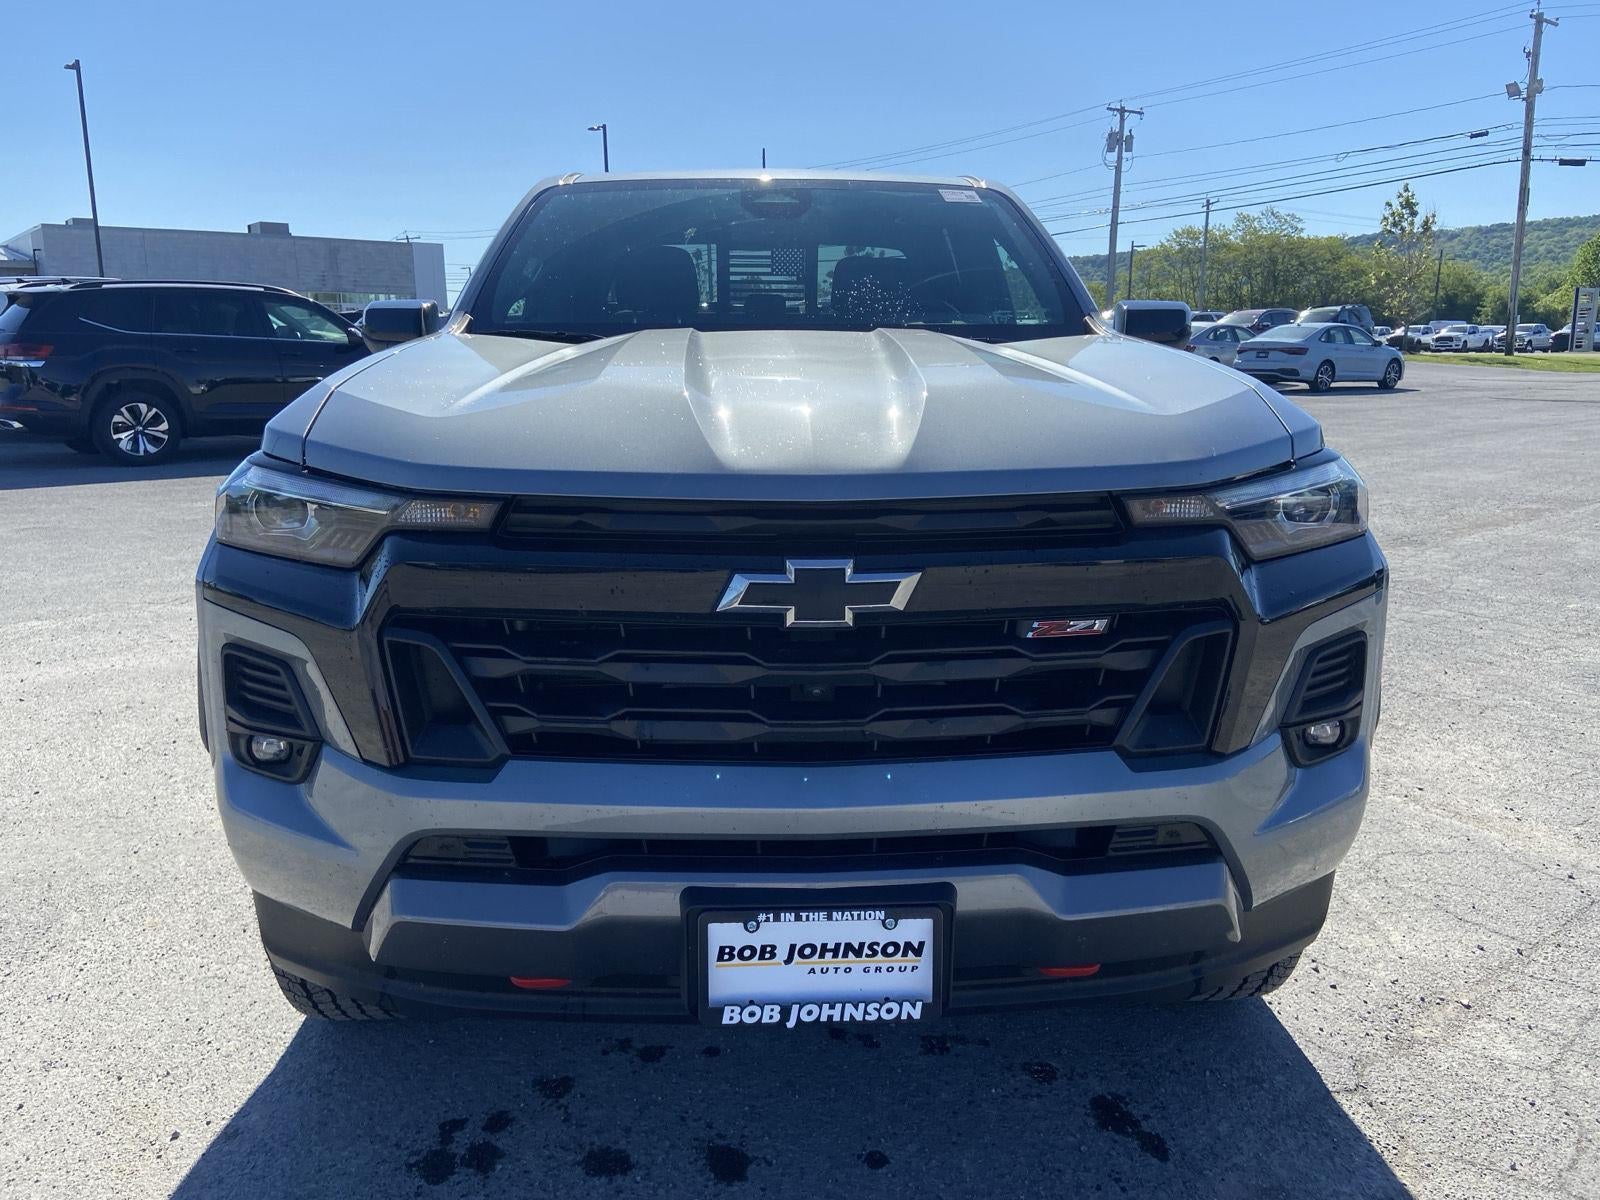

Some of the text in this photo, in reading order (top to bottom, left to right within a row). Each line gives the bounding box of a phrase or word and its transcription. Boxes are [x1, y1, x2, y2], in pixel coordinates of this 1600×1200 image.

[1026, 619, 1108, 638] Z71
[757, 910, 885, 923] #1 IN THE NATION
[716, 940, 925, 966] BOB JOHNSON
[807, 965, 919, 975] AUTO GROUP
[721, 1001, 923, 1029] BOB JOHNSON
